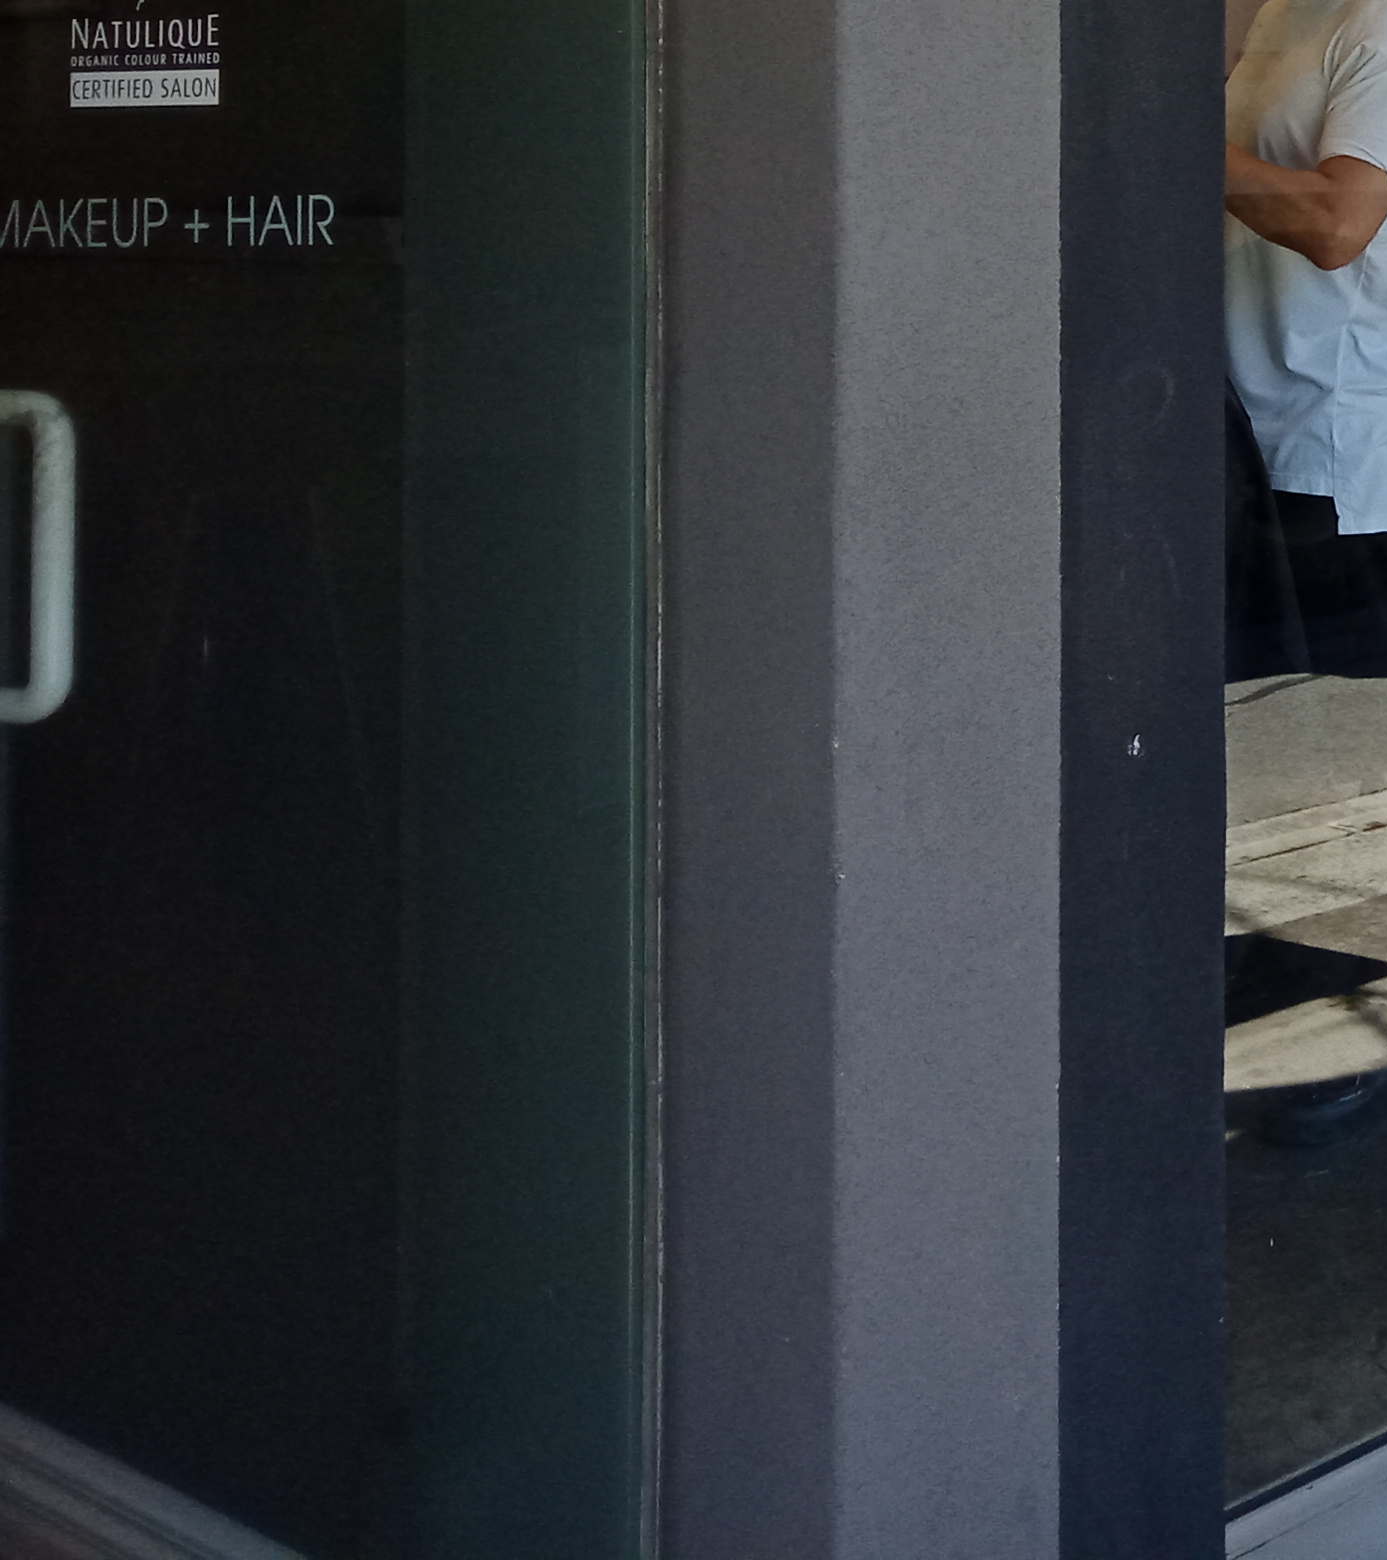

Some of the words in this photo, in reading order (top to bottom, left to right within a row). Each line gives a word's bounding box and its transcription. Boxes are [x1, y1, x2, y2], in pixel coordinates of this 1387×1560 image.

[71, 13, 220, 50] NATULIQUE
[70, 54, 120, 67] ORGANIC
[124, 53, 168, 66] COLOUR
[172, 52, 221, 65] TRAINED
[72, 78, 154, 101] CERTIFIED
[160, 76, 217, 99] SALON
[227, 194, 335, 247] HAIR
